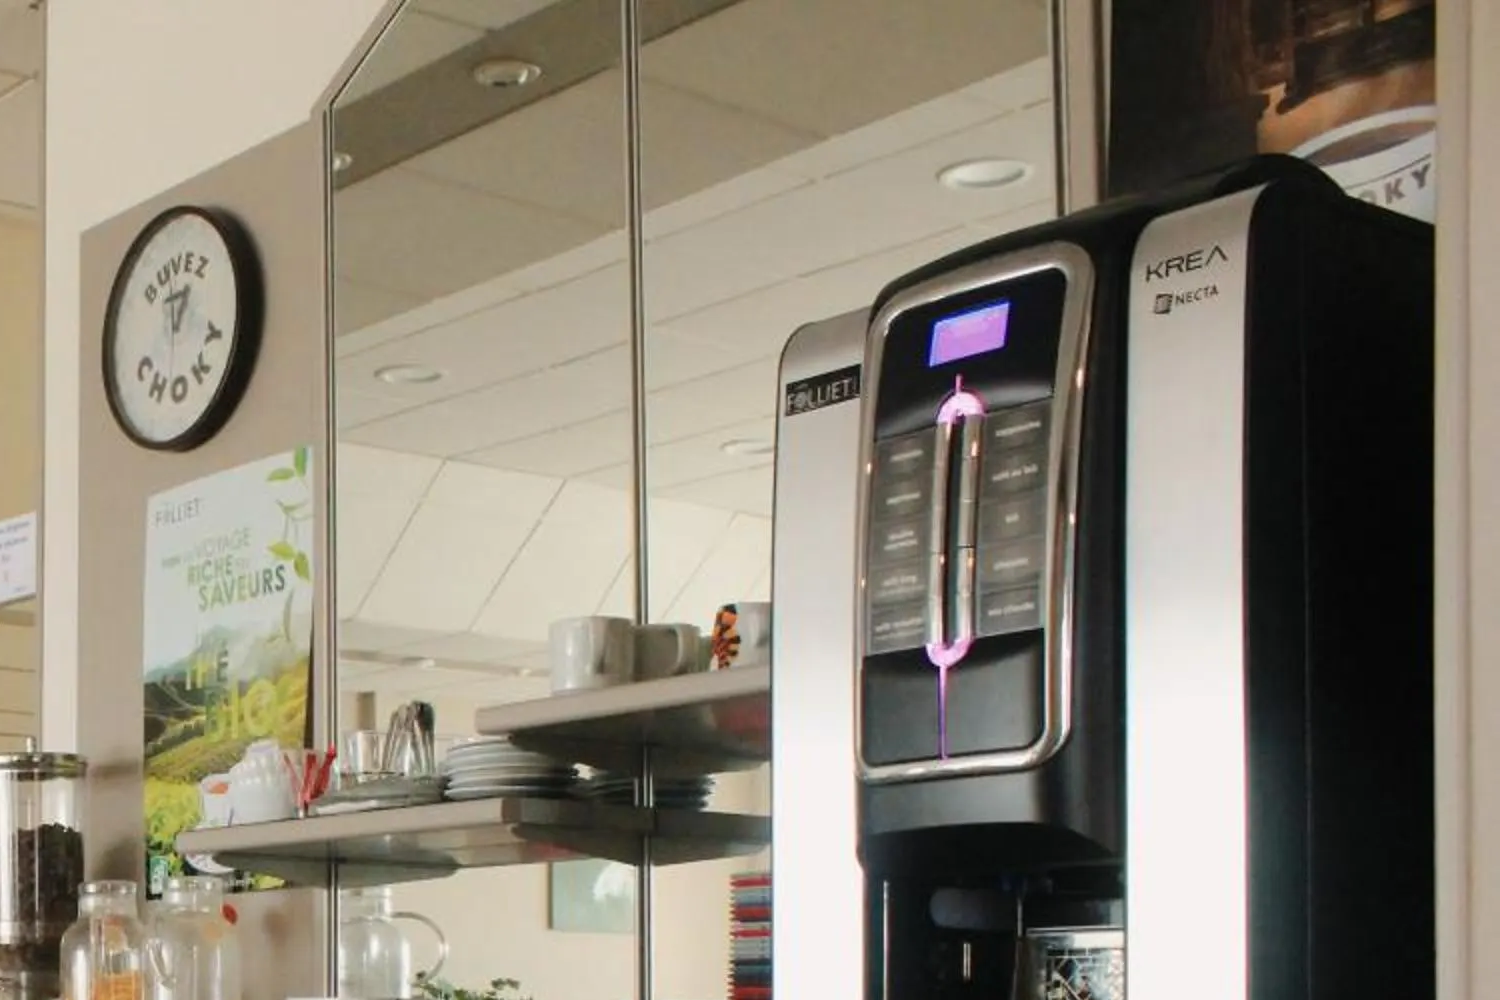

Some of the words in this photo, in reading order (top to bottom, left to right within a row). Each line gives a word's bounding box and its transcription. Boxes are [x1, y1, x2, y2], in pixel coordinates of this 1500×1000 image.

[144, 251, 210, 305] BUVEZ
[1145, 245, 1228, 283] KREA
[1175, 284, 1219, 305] NECTA
[137, 320, 223, 404] CHOKY
[187, 553, 233, 586] RICHE
[198, 563, 286, 613] SAVEURS
